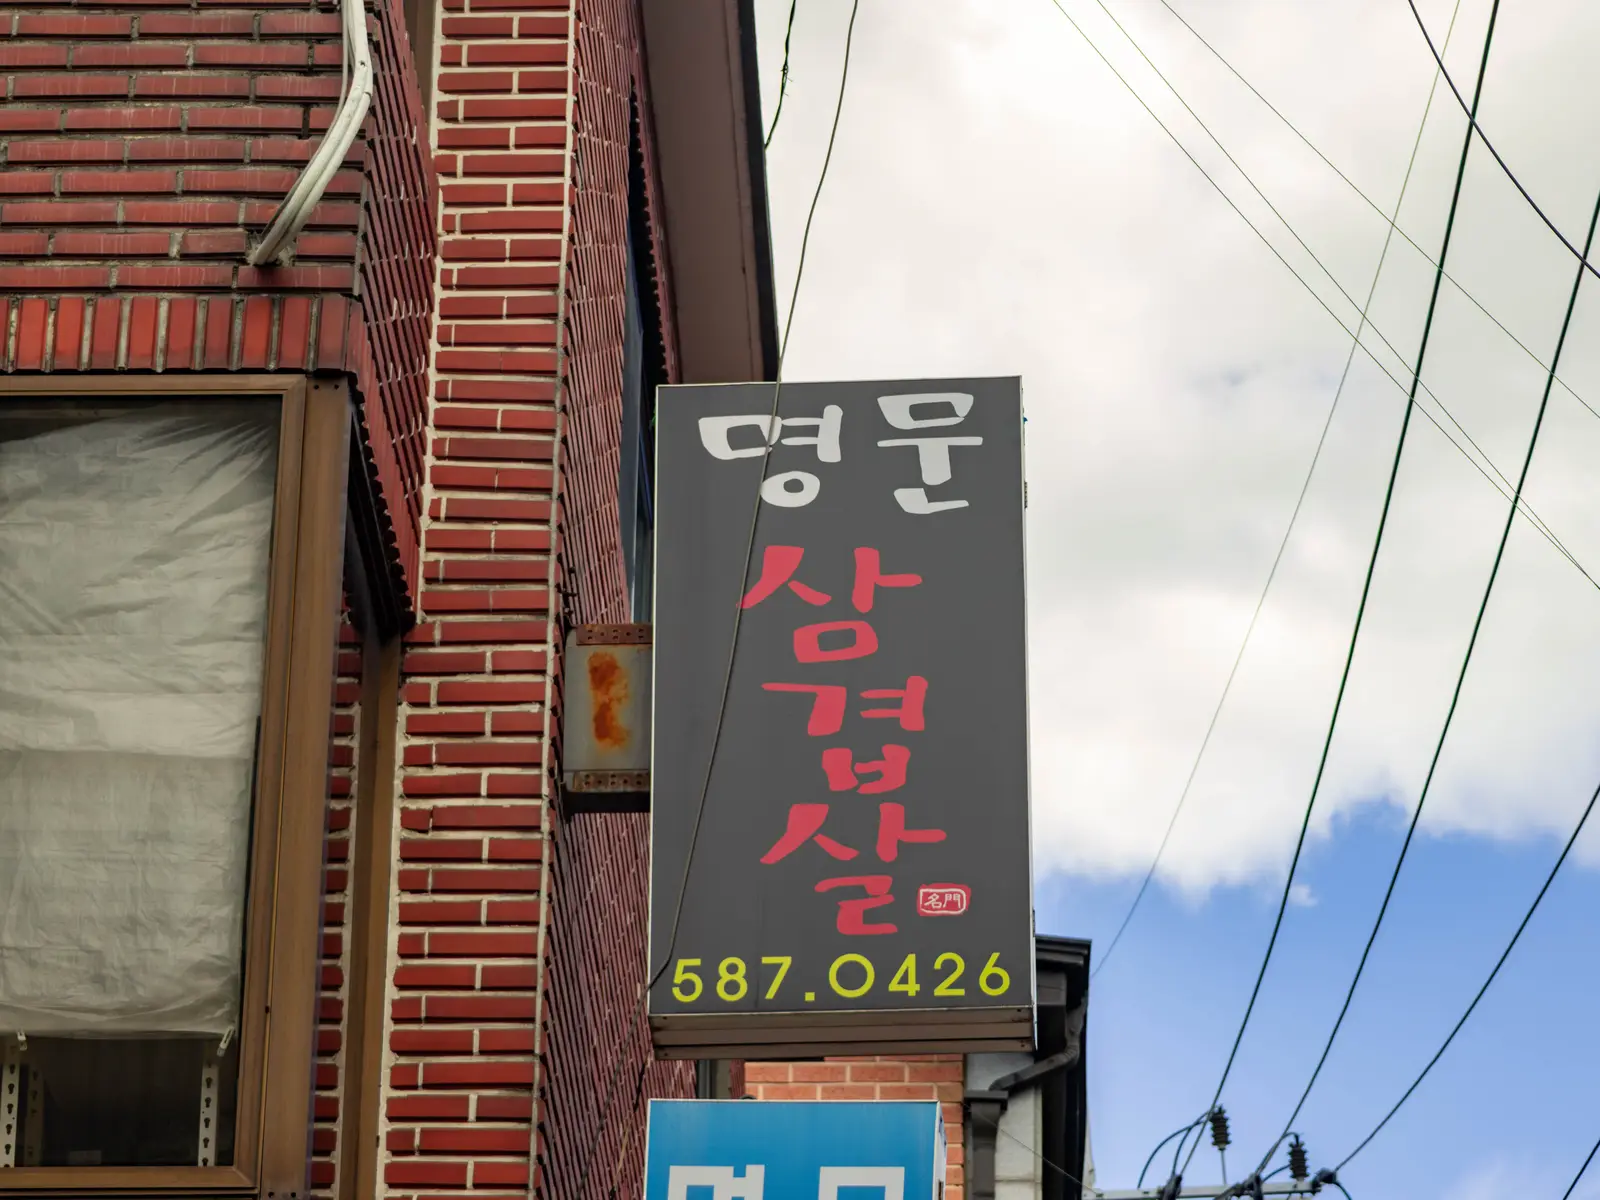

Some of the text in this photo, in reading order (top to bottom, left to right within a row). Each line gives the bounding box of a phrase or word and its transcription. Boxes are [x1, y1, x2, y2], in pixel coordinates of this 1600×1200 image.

[698, 392, 984, 515] 명문
[736, 545, 947, 935] 삼겹살
[923, 892, 962, 909] 名門
[671, 952, 1011, 1003] 587.0426
